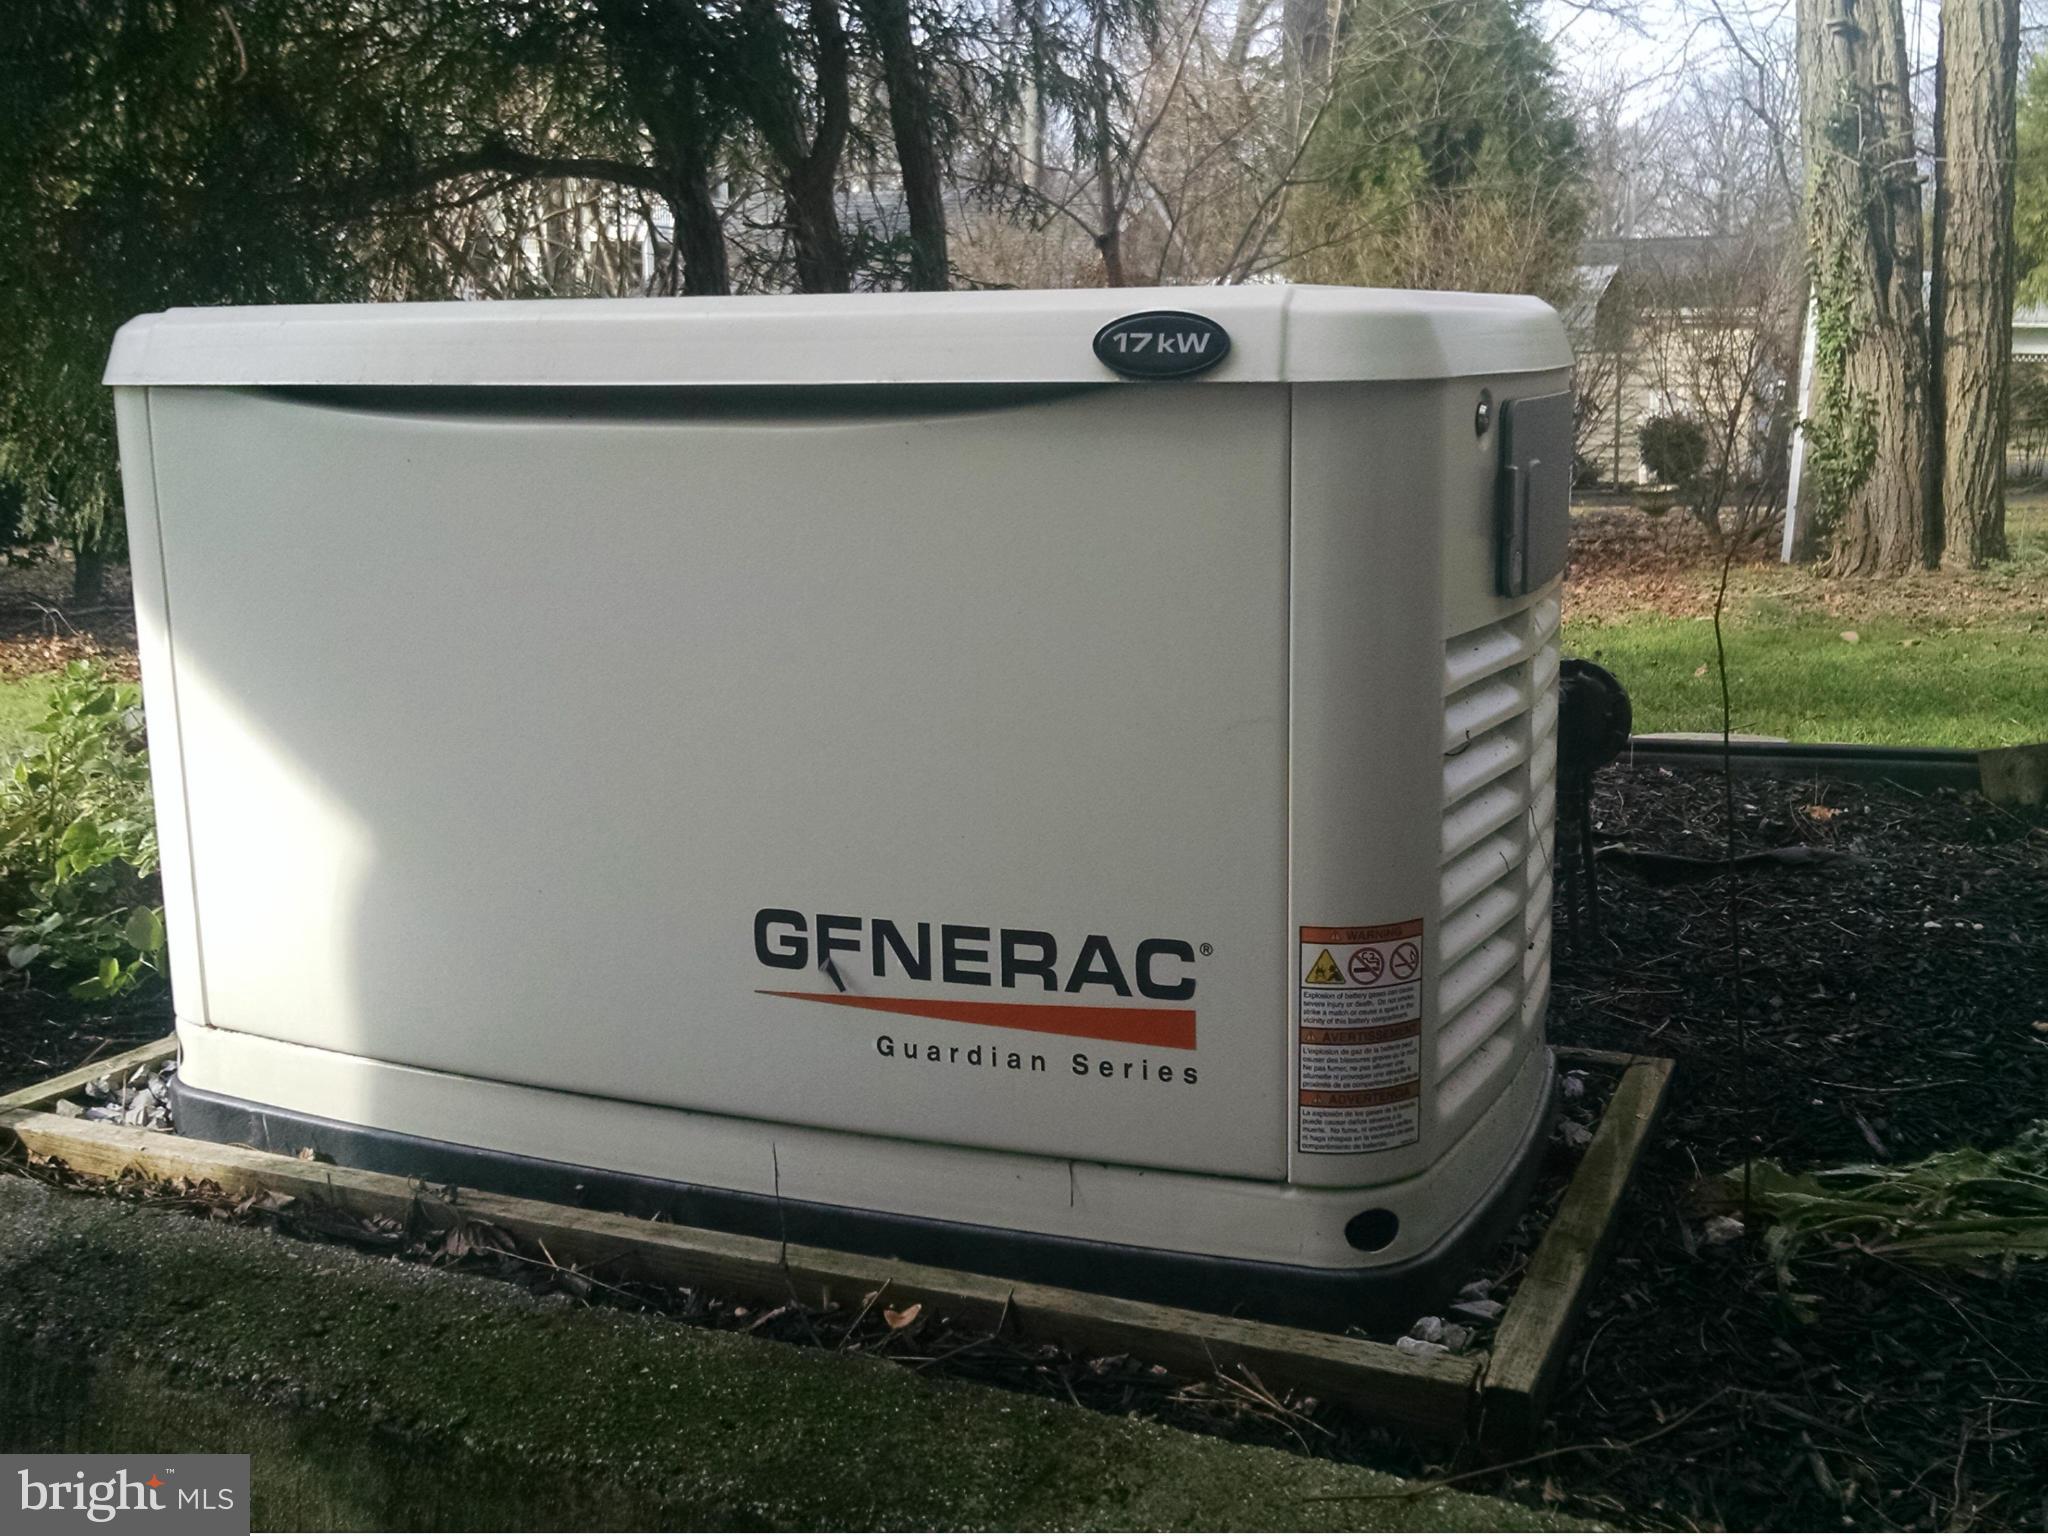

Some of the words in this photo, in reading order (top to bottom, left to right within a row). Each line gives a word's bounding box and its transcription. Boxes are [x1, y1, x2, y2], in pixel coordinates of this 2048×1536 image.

[1346, 926, 1403, 941] WARNING
[1303, 991, 1335, 1000] Explosion
[1336, 991, 1344, 999] of
[1345, 991, 1368, 1000] battery
[1327, 1000, 1345, 1009] injury
[876, 1035, 1046, 1072] Guardian
[1071, 1053, 1198, 1085] Series
